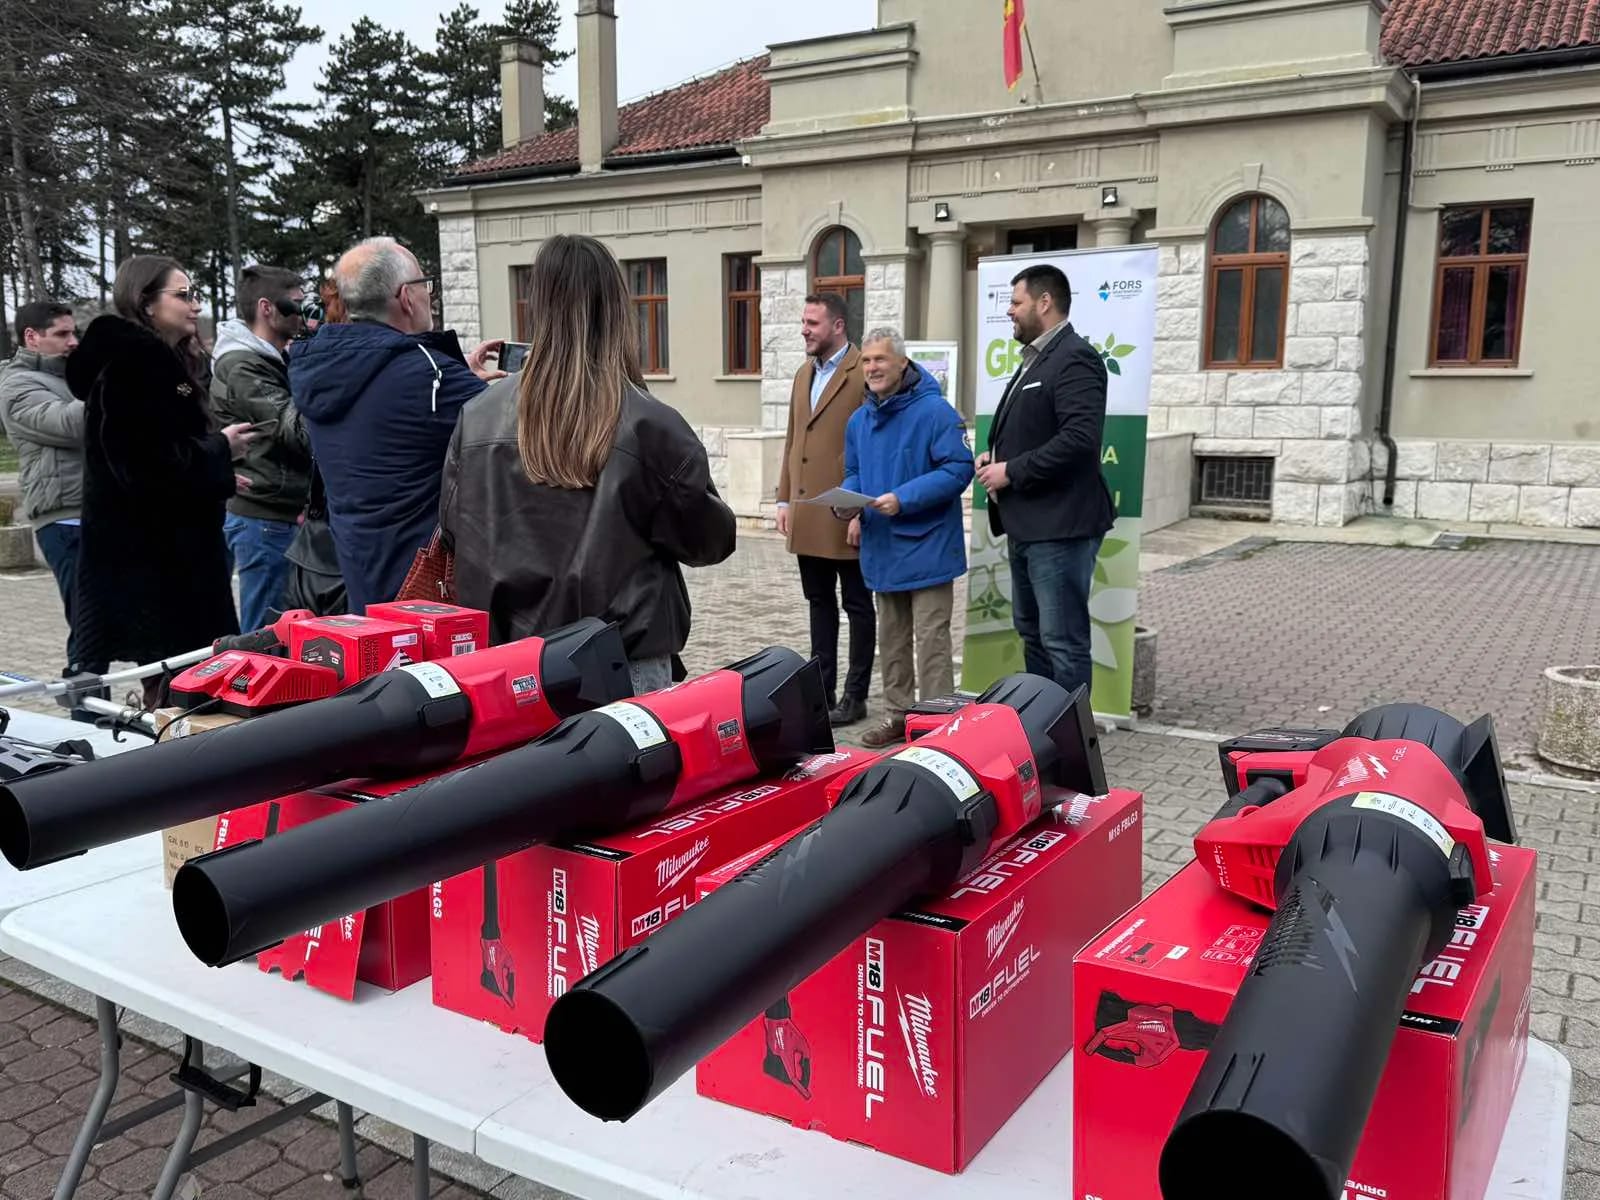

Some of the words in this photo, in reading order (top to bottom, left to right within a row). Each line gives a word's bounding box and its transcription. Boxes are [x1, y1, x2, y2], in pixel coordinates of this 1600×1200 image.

[1112, 280, 1142, 290] FORS
[635, 800, 742, 839] FUEL
[1023, 830, 1067, 852] M18
[655, 836, 709, 887] Milwaukee
[950, 849, 1039, 899] FUEL
[432, 880, 443, 919] BLG3
[553, 867, 567, 915] M18
[632, 906, 662, 937] M18
[986, 896, 1024, 958] Milwaukee
[1454, 904, 1490, 930] M18
[553, 917, 567, 998] FUE
[866, 936, 884, 993] M18
[969, 981, 991, 1020] M18
[993, 943, 1041, 998] FUEL
[857, 1003, 864, 1016] TO
[866, 993, 884, 1120] FUEL
[905, 991, 939, 1098] Milwaukee
[1344, 1179, 1387, 1198] DRIVE
